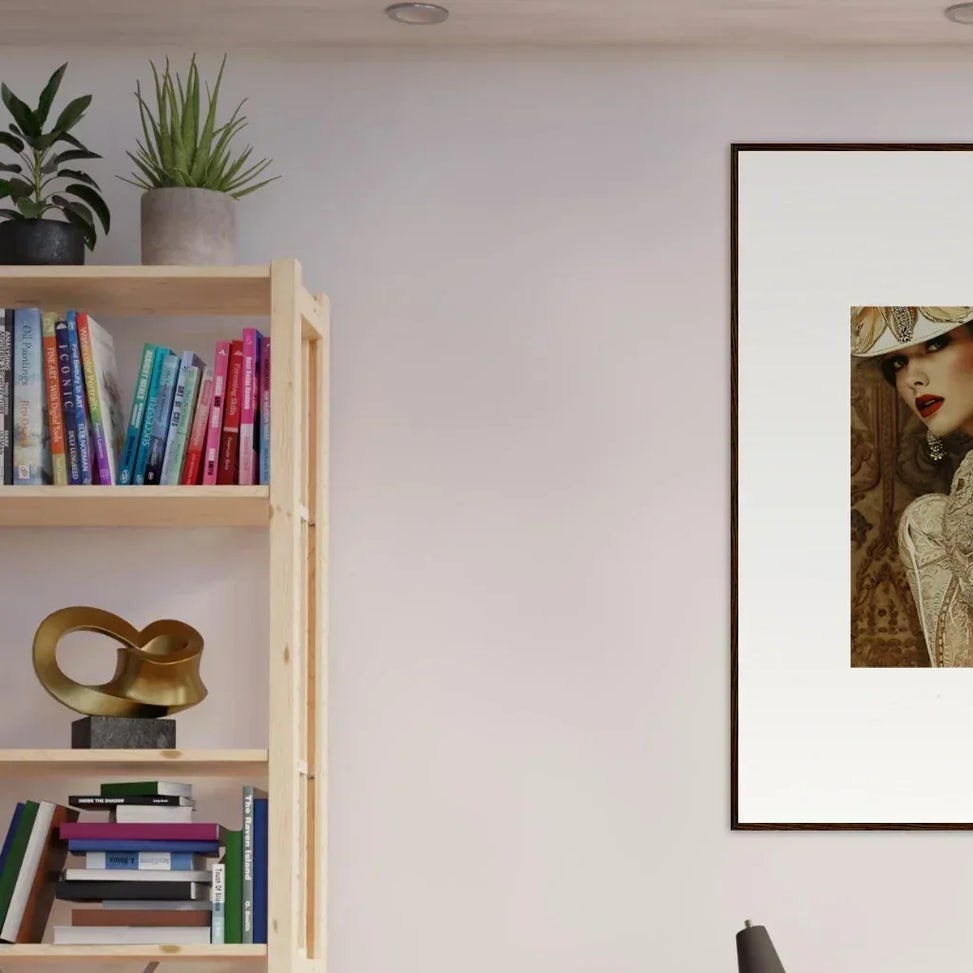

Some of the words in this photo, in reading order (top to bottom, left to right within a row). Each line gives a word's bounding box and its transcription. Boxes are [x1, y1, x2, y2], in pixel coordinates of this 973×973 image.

[21, 325, 32, 340] Oil
[47, 347, 55, 365] FINE
[80, 327, 93, 373] Watercolor
[19, 343, 32, 387] Paintings
[48, 366, 56, 379] ART
[230, 363, 240, 396] Parenting
[85, 374, 97, 411] Portraits
[50, 403, 60, 425] Digital
[229, 397, 240, 416] Skills
